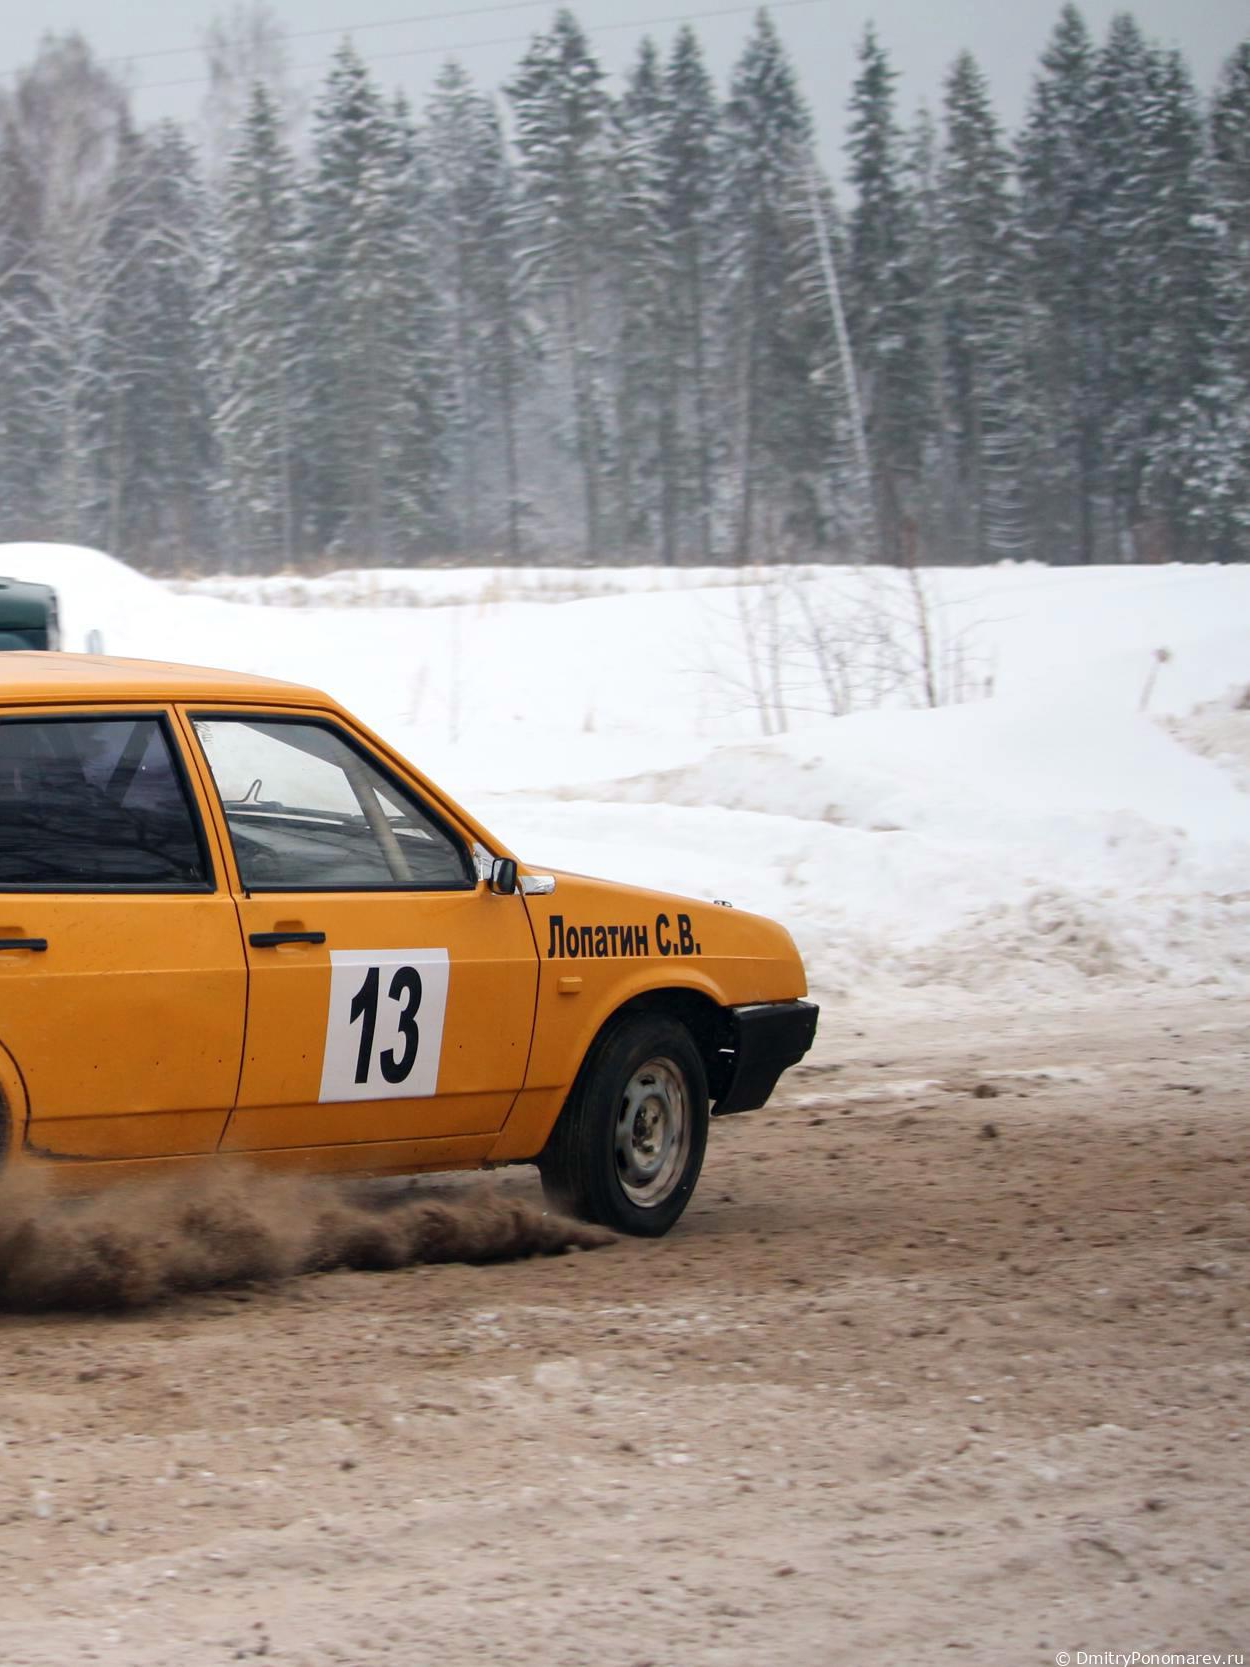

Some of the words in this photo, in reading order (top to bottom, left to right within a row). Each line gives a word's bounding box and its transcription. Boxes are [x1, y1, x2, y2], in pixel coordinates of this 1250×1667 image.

[548, 915, 649, 958] Лопатин
[656, 913, 702, 956] С.В.
[350, 966, 422, 1084] 13
